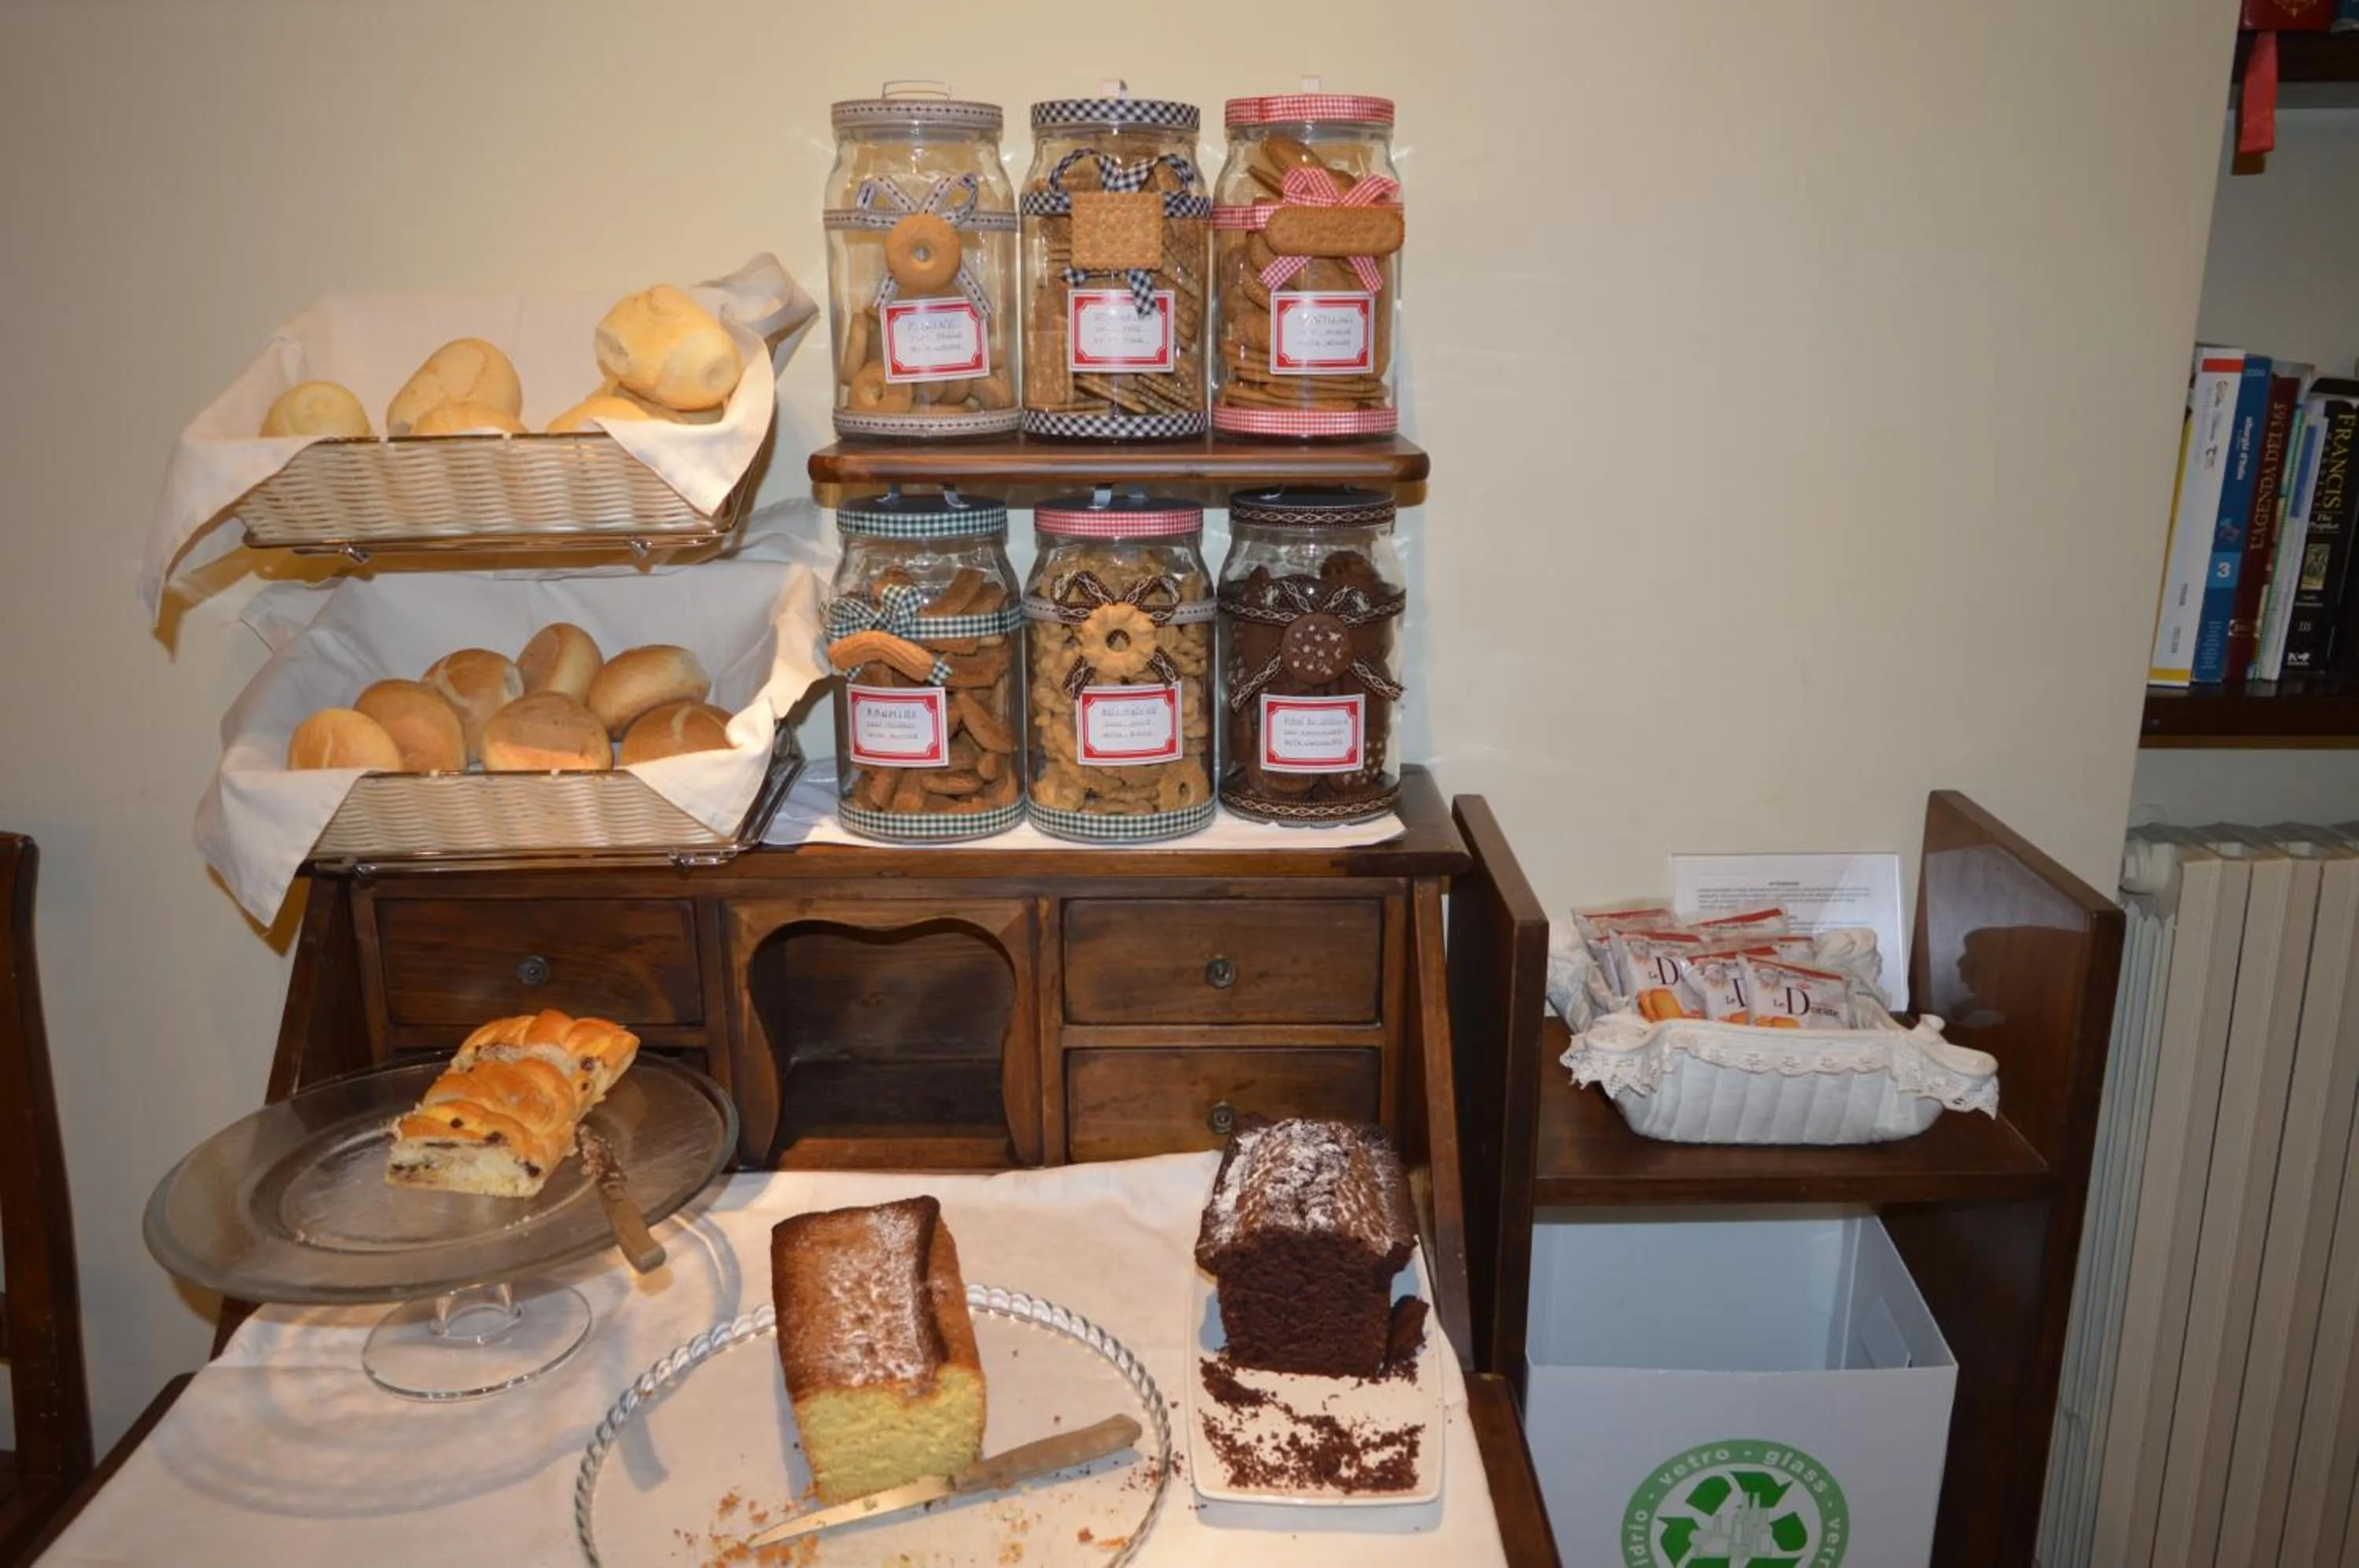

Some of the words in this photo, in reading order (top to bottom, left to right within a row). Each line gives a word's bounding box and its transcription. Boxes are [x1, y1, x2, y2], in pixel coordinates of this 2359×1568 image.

[2323, 414, 2357, 509] FRANCIS
[2250, 466, 2277, 550] L'AGENDA
[2217, 561, 2232, 579] 3
[1627, 1509, 1649, 1568] idrio
[1658, 1448, 1731, 1485] vetro
[1762, 1448, 1829, 1493] glass
[1818, 1518, 1841, 1568] verr
